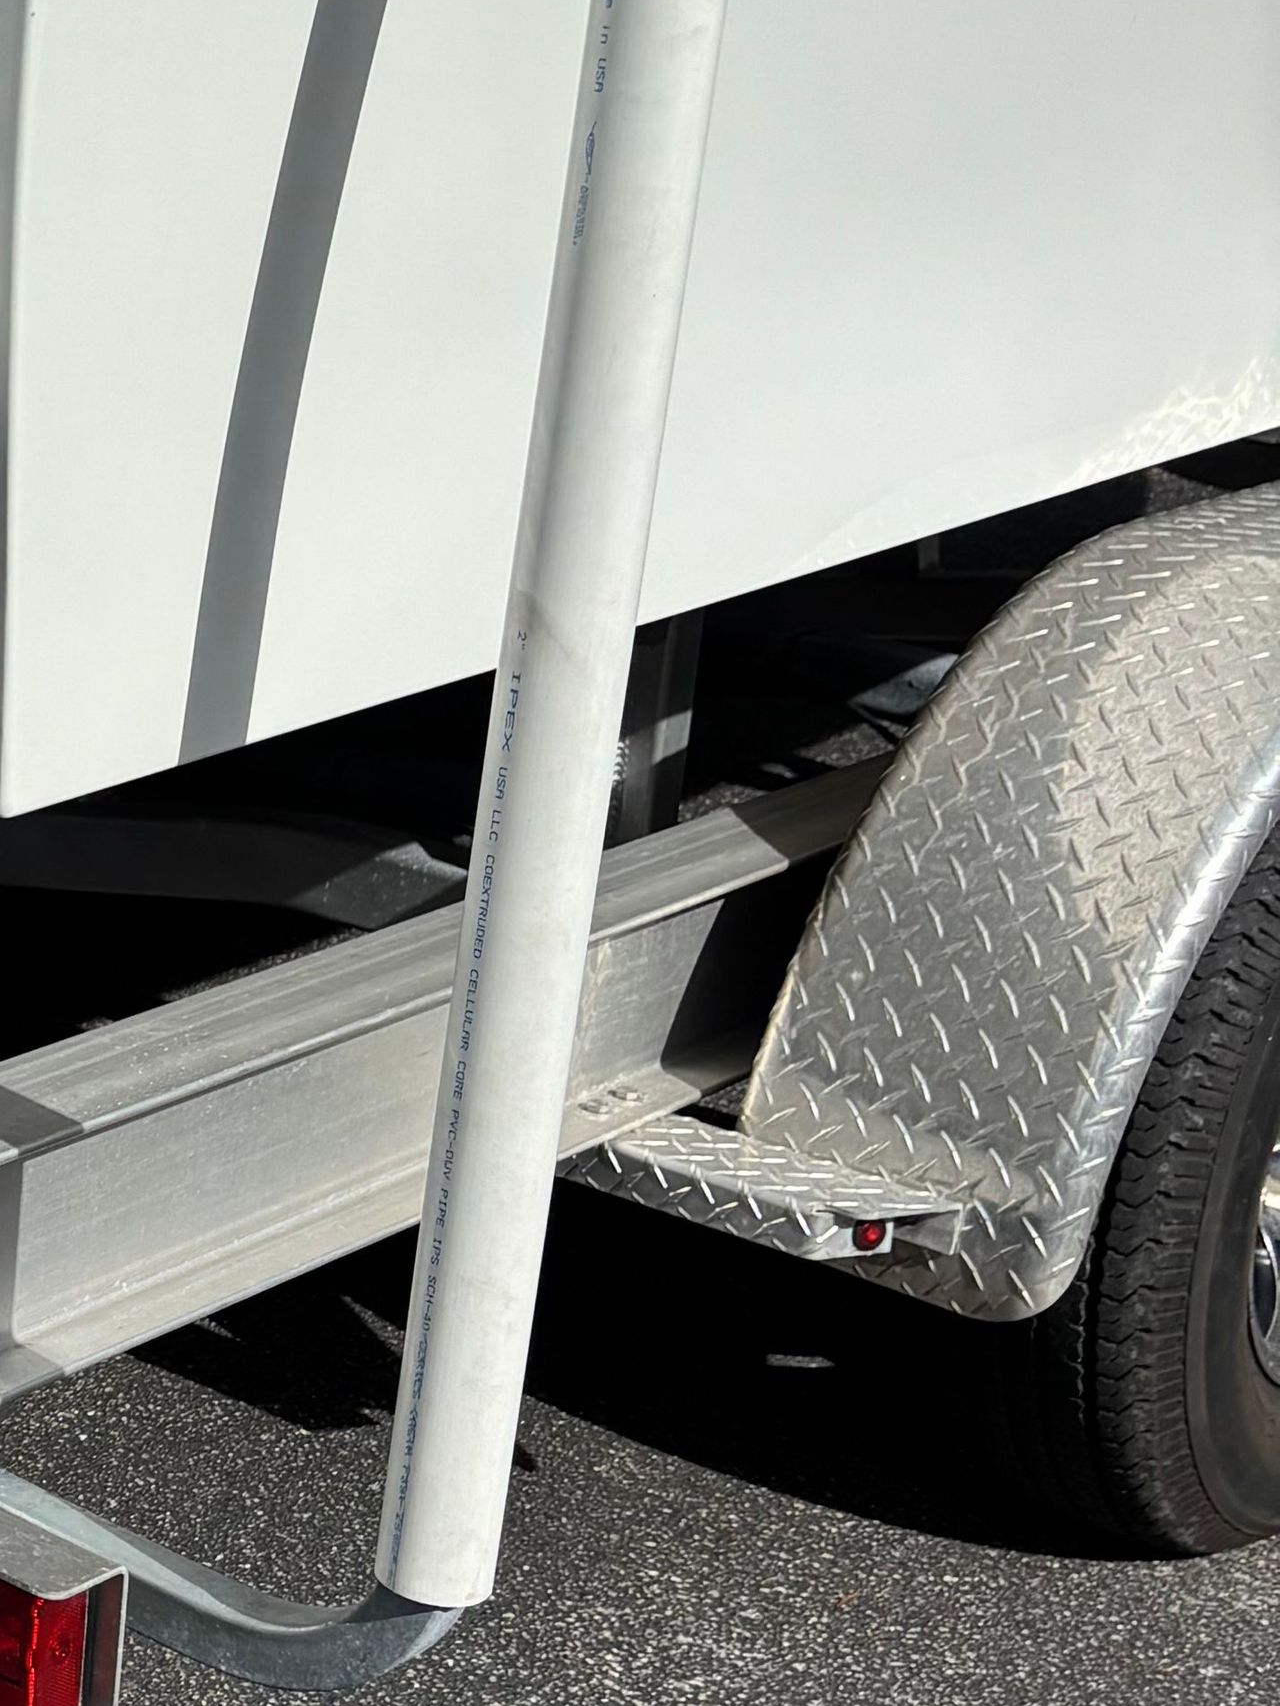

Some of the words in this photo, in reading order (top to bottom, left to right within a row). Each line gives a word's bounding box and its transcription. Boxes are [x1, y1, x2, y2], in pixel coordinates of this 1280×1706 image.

[594, 57, 606, 93] USA
[502, 670, 520, 753] IPEX
[495, 765, 507, 800] USA
[489, 808, 501, 842] LLC
[473, 853, 495, 959] COEXTRUDED
[460, 968, 479, 1052] CELLULAR
[453, 1060, 466, 1101] CORE
[435, 1187, 449, 1228] PIPE
[430, 1236, 442, 1266] IPS
[421, 1274, 437, 1332] SCH-40
